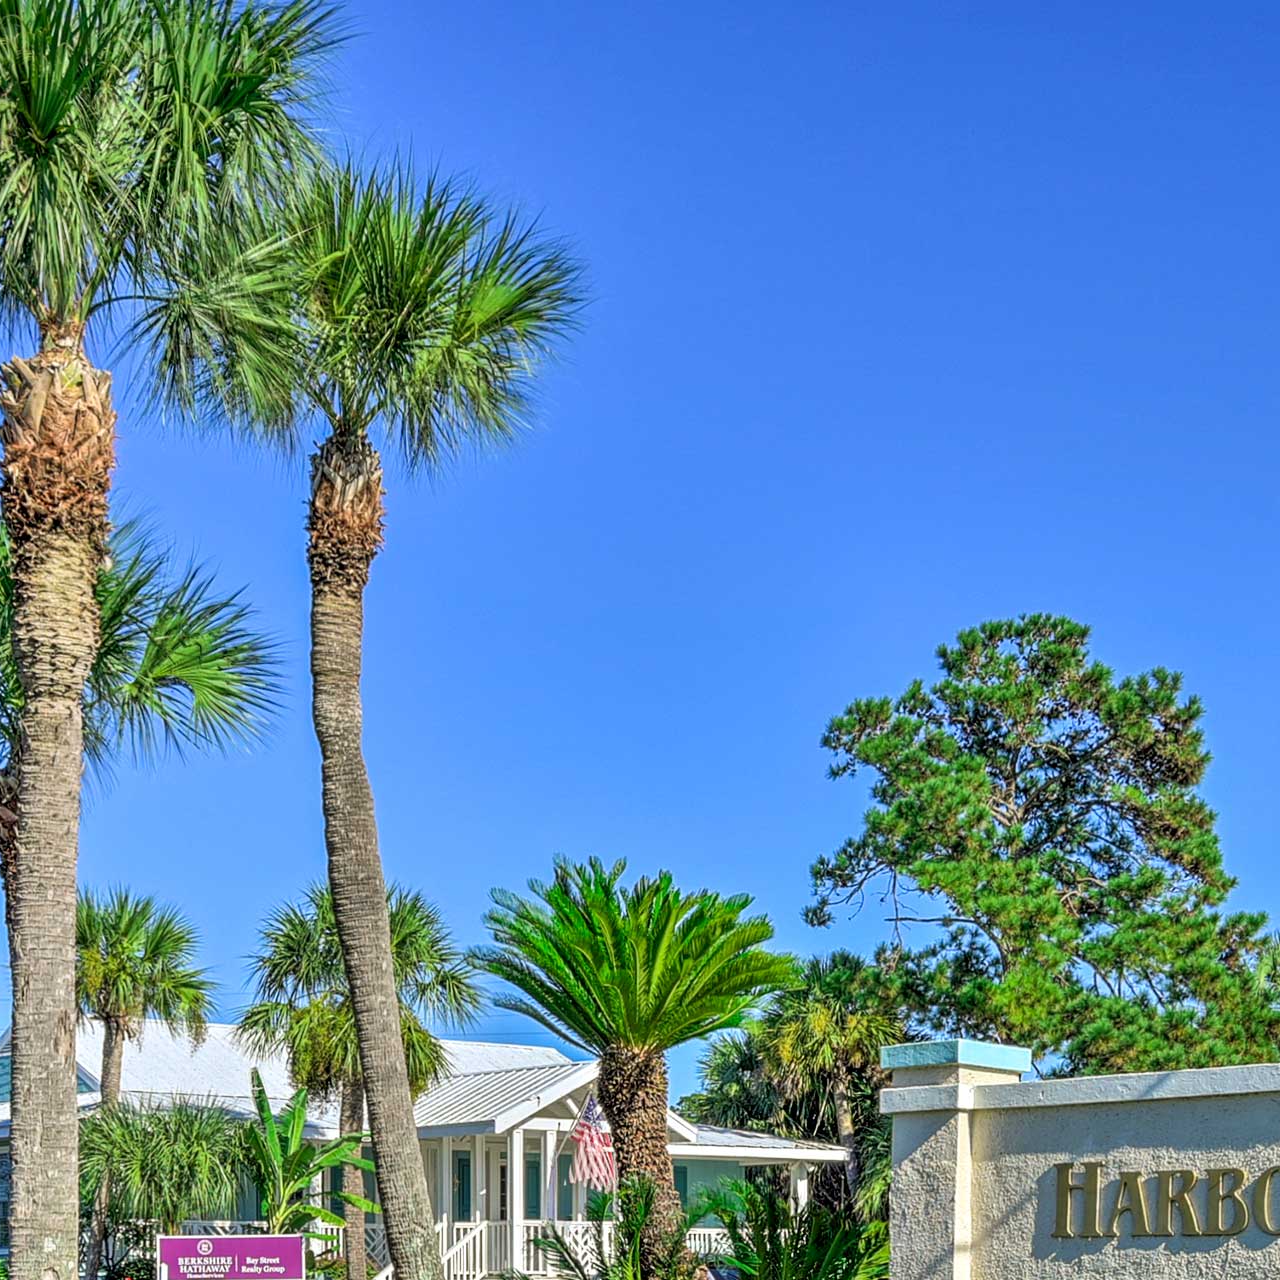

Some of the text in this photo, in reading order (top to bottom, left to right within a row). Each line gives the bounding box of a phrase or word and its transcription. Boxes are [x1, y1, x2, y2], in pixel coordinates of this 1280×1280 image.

[178, 1256, 233, 1265] BERKSHIRE
[246, 1256, 280, 1266] Bay Street
[180, 1265, 231, 1273] HATHAWAY
[241, 1265, 286, 1274] Realty Group
